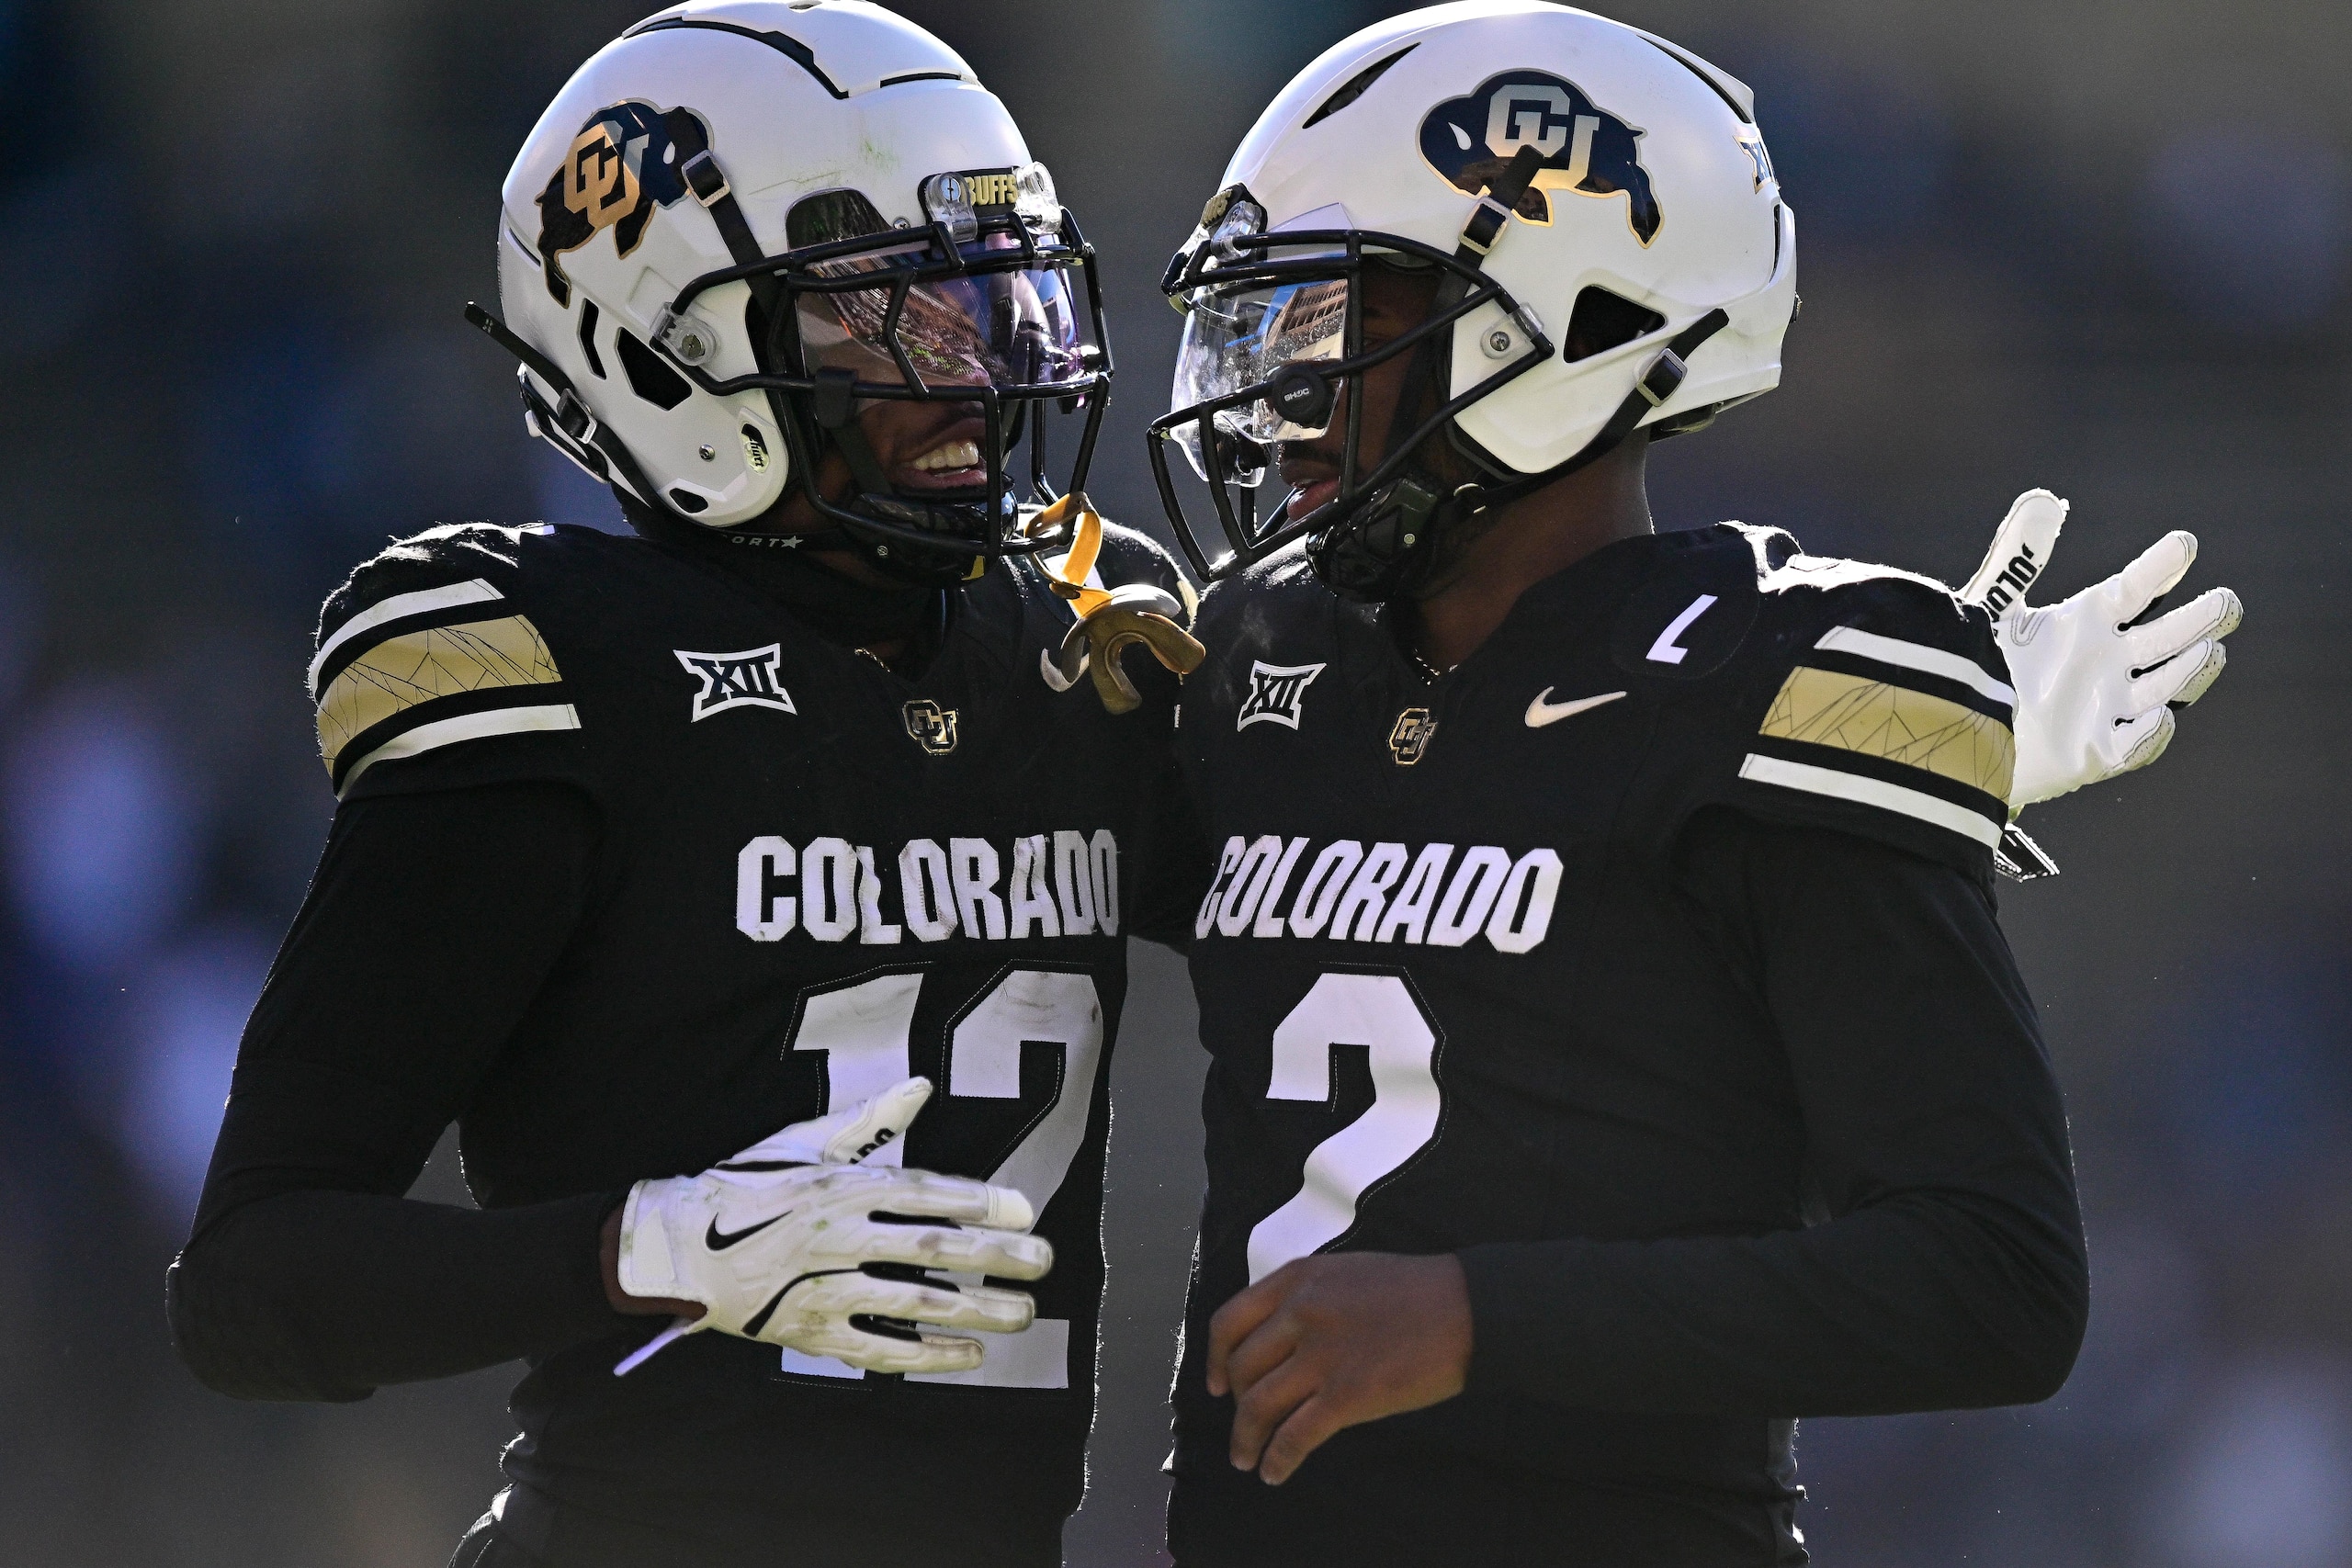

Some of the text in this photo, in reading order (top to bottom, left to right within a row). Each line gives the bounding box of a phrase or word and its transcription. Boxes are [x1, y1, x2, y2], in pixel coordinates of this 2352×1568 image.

[736, 829, 1118, 944] COLORADO
[1195, 834, 1564, 954] COLORADO
[781, 969, 1103, 1389] 12
[1247, 973, 1441, 1287] 2
